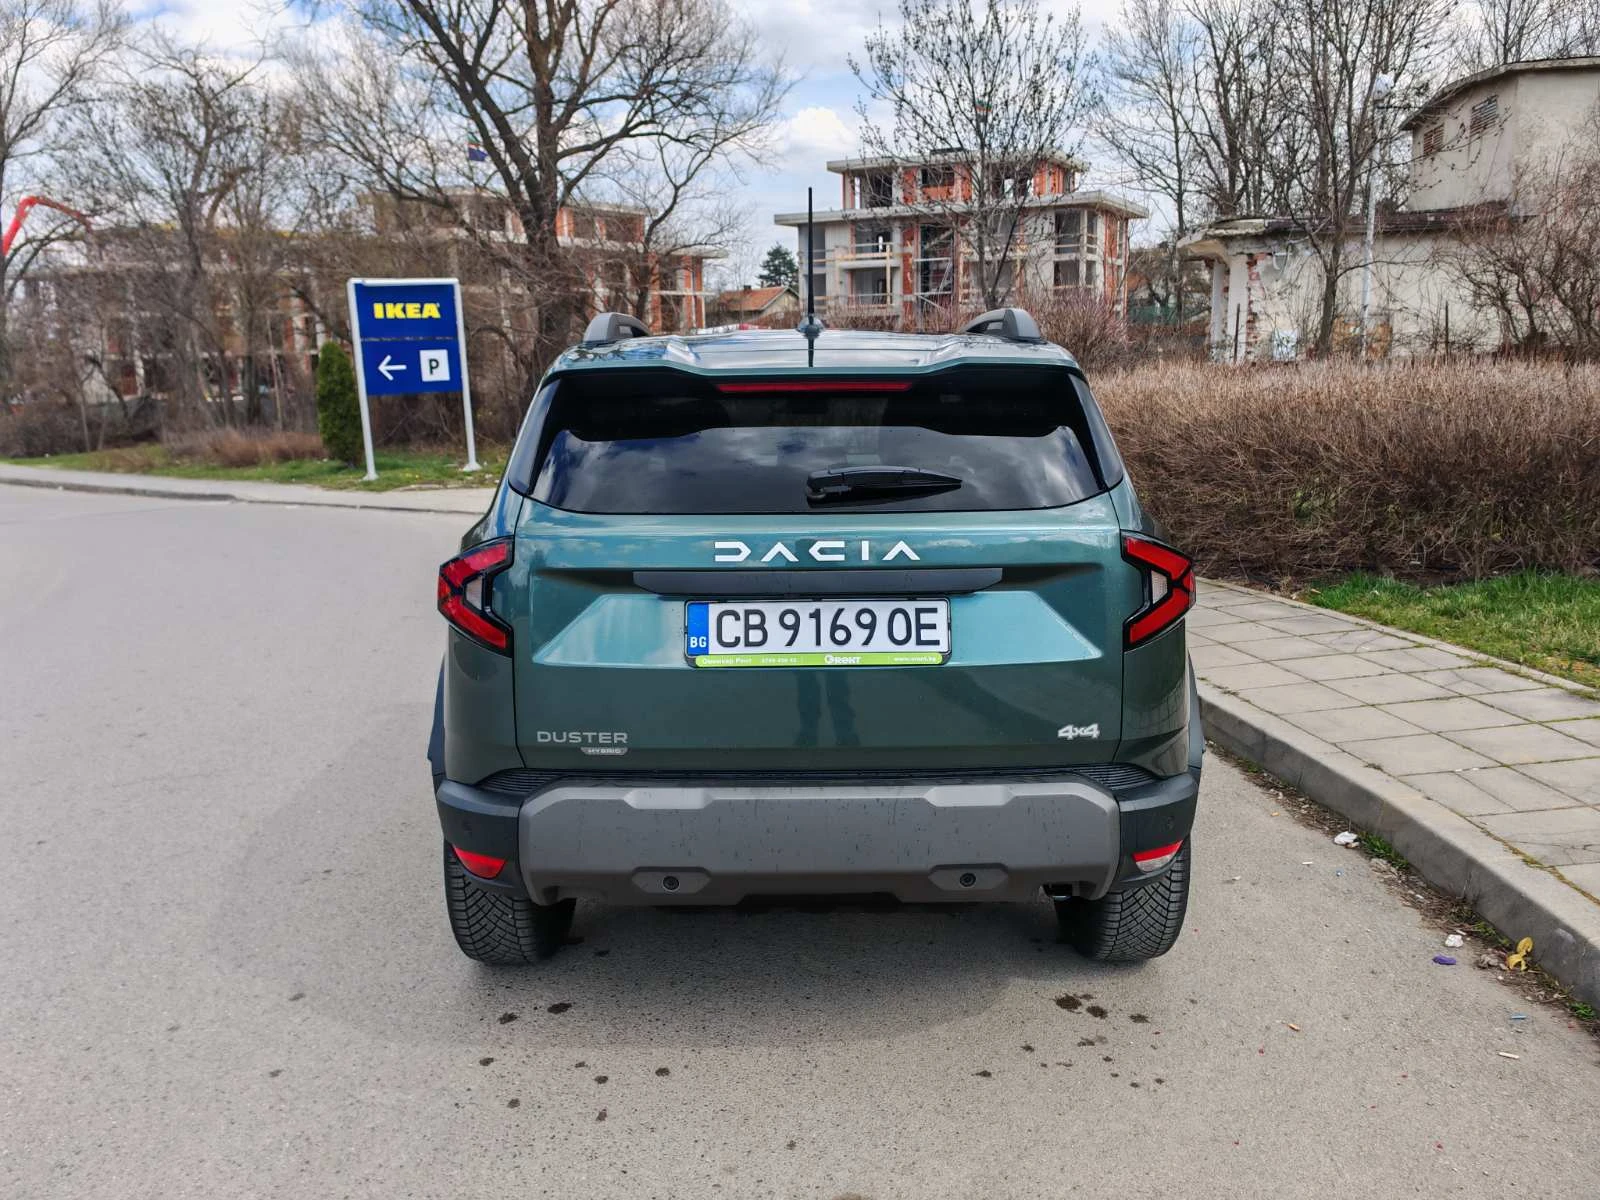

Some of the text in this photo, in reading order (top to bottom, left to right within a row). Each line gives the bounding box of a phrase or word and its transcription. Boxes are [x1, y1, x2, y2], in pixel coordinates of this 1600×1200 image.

[373, 302, 441, 319] IKEA
[428, 358, 440, 375] P
[714, 540, 921, 562] DACIA
[716, 608, 768, 648] CB
[778, 607, 877, 647] 9169
[690, 636, 707, 648] BG
[536, 730, 628, 744] DUSTER
